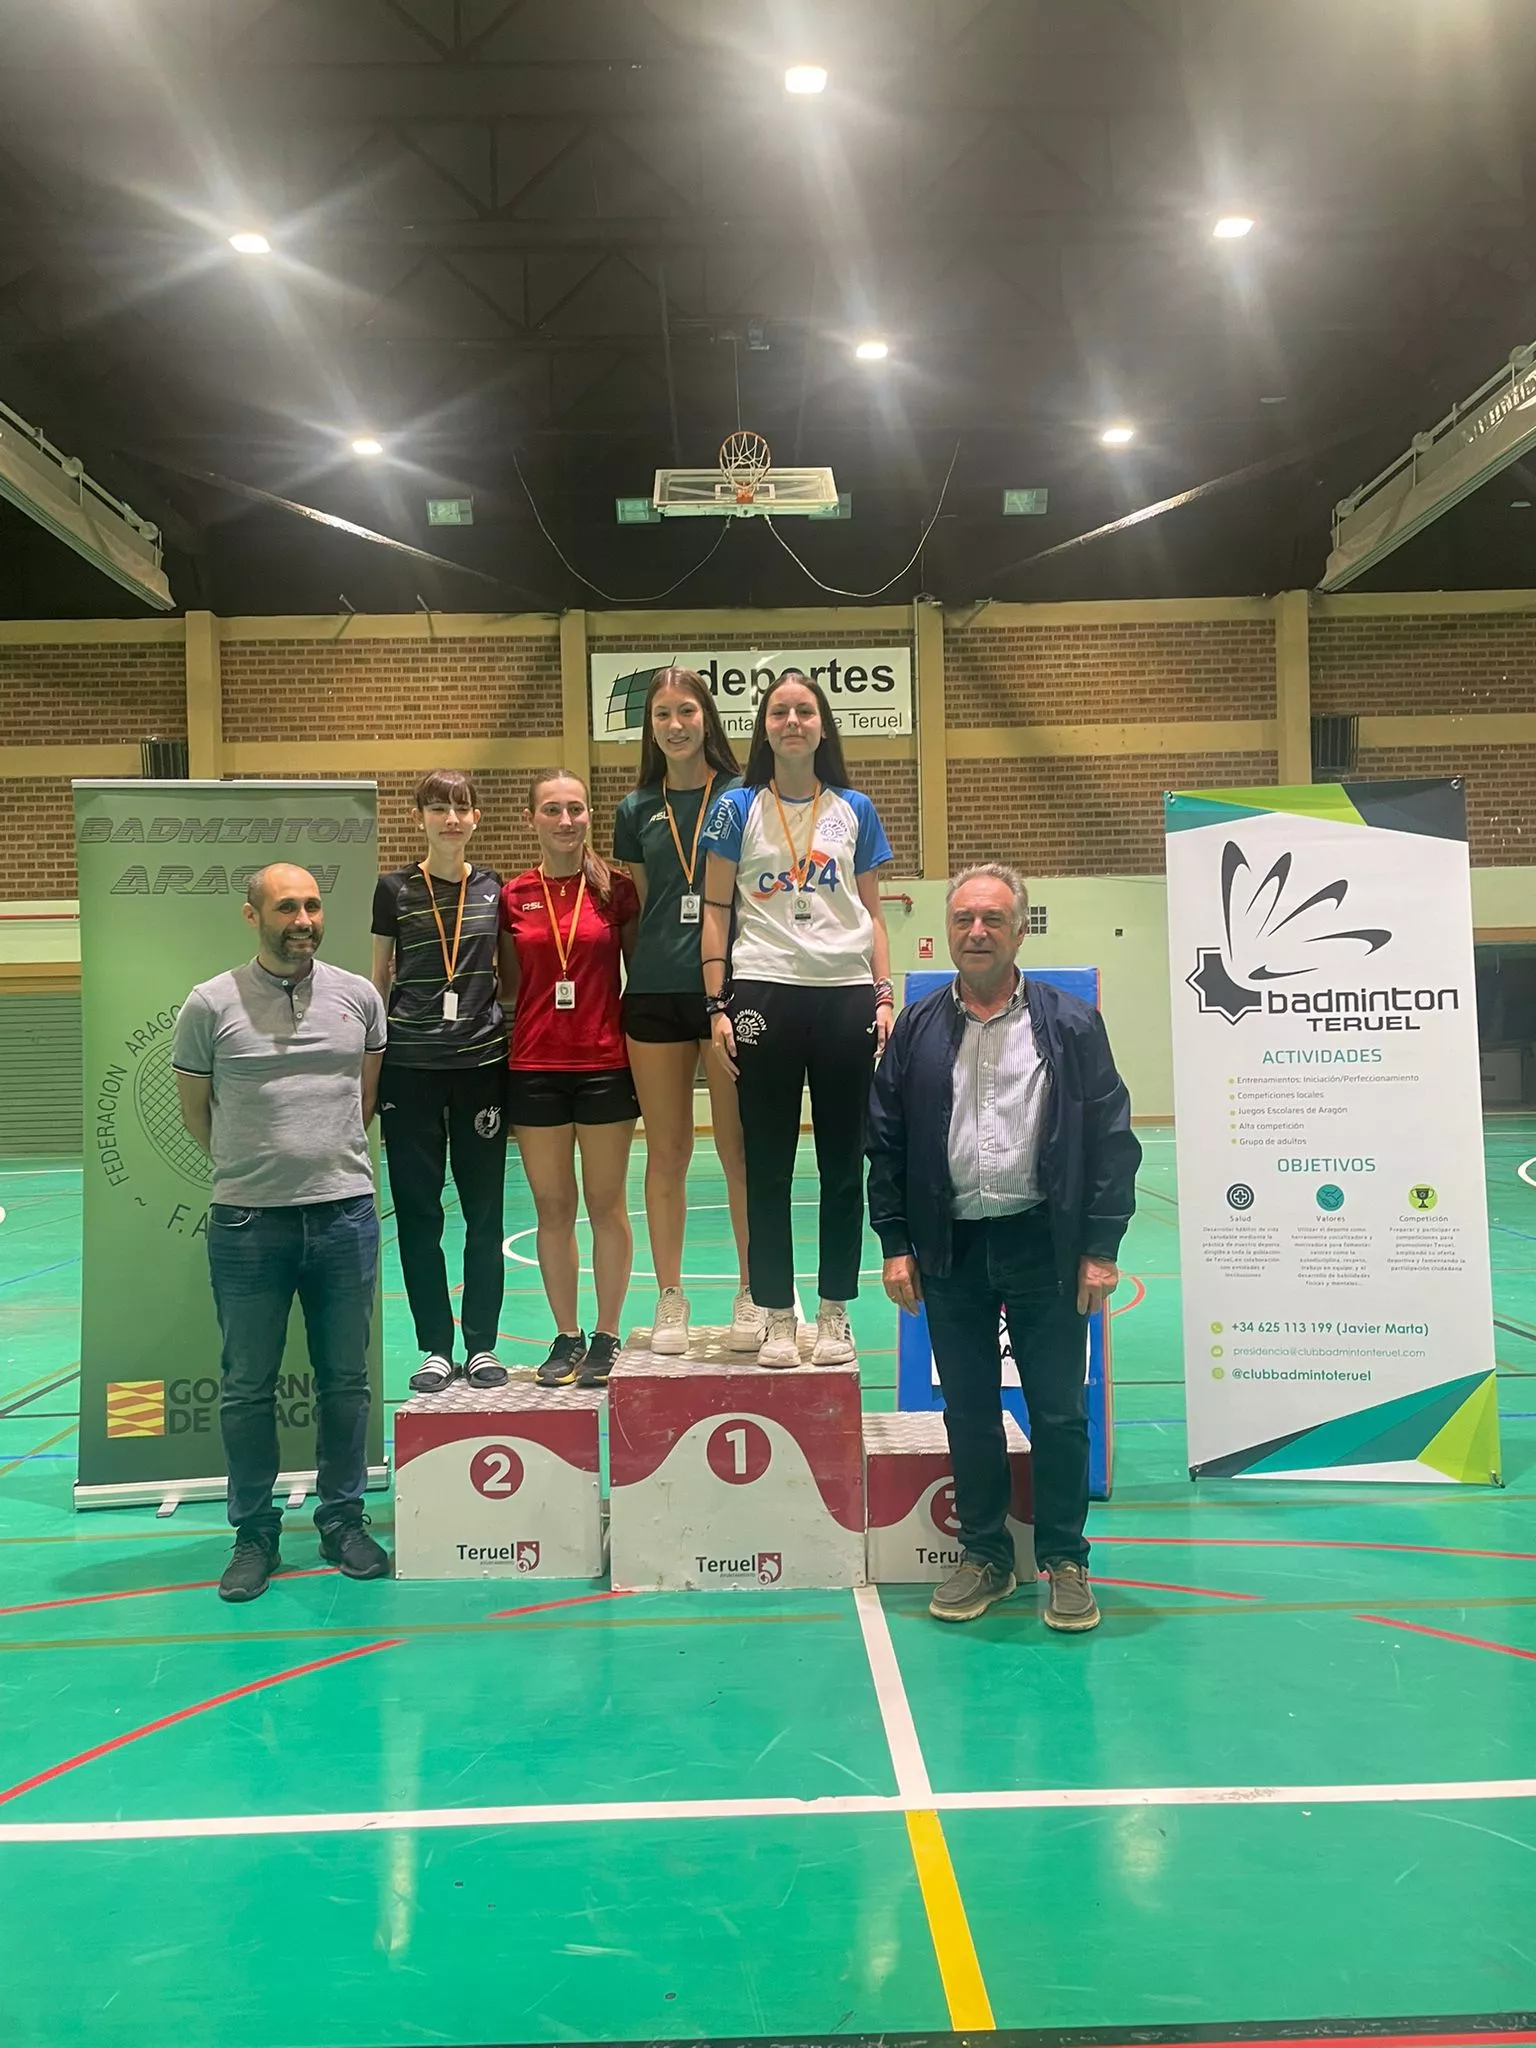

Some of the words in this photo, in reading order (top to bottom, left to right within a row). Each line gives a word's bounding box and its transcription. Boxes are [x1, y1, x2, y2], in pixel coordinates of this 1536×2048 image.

[697, 657, 895, 706] deprtes
[849, 712, 903, 729] Teruel
[79, 817, 375, 844] BADMINTON
[522, 902, 544, 912] RSL
[1267, 987, 1459, 1014] badminton
[1306, 1016, 1421, 1032] TERUEL
[1262, 1048, 1382, 1064] ACTIVIDADES
[1237, 1091, 1295, 1100] Competiciones
[1238, 1108, 1265, 1116] Juegos
[1267, 1107, 1304, 1115] Escolares
[1306, 1106, 1316, 1114] de
[1318, 1106, 1348, 1115] Aragón
[97, 1063, 129, 1187] FEDERACION
[1239, 1122, 1255, 1130] Alta
[1256, 1122, 1304, 1131] competición
[1239, 1138, 1264, 1147] Grupo
[1265, 1137, 1275, 1145] de
[1277, 1137, 1307, 1145] adultos
[1277, 1158, 1376, 1172] OBJETIVOS
[1399, 1215, 1449, 1223] Competición
[1231, 1322, 1254, 1332] +34
[1258, 1322, 1280, 1332] 625
[1285, 1322, 1307, 1332] 113
[1311, 1322, 1332, 1332] 199
[1336, 1322, 1381, 1336] (Javier
[1385, 1323, 1429, 1336] Marta)
[1231, 1368, 1371, 1381] @clubbadmintoteruel
[169, 1407, 211, 1434] DE
[725, 1429, 747, 1475] 1
[483, 1452, 512, 1491] 2
[456, 1543, 514, 1560] Teruel
[916, 1548, 959, 1564] Teru
[695, 1554, 755, 1573] Teruel
